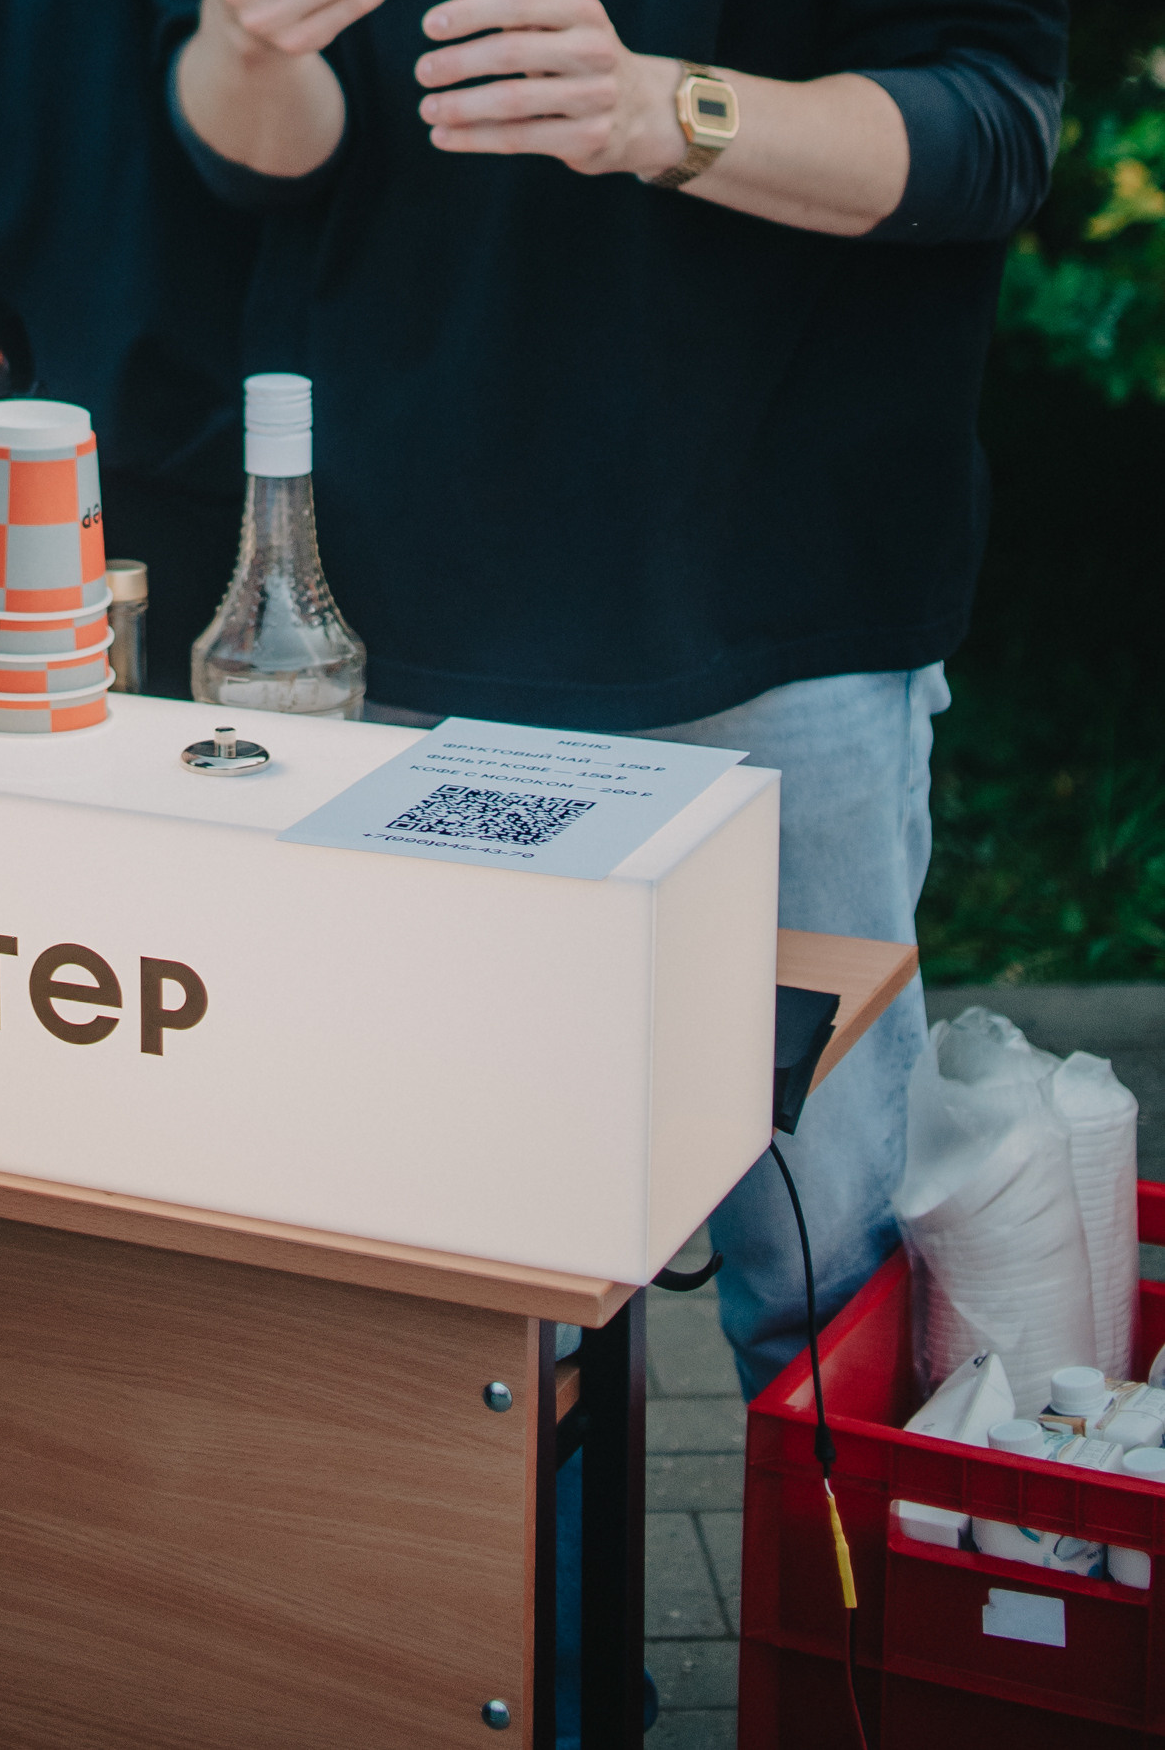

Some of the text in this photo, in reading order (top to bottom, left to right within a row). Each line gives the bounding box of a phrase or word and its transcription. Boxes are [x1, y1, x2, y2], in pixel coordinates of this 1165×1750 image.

[442, 743, 552, 759] ФРУКТОВЫЙ
[555, 755, 591, 764] ЧАЙ
[615, 762, 651, 771] 150
[557, 740, 612, 750] МЕНЮ
[410, 765, 461, 776] КОФЕ
[480, 773, 574, 789] МОЛОКОМ
[599, 787, 637, 796] 200
[426, 754, 498, 766] ФИЛЬТР
[500, 763, 552, 772] КОФЕ
[576, 772, 612, 780] 150
